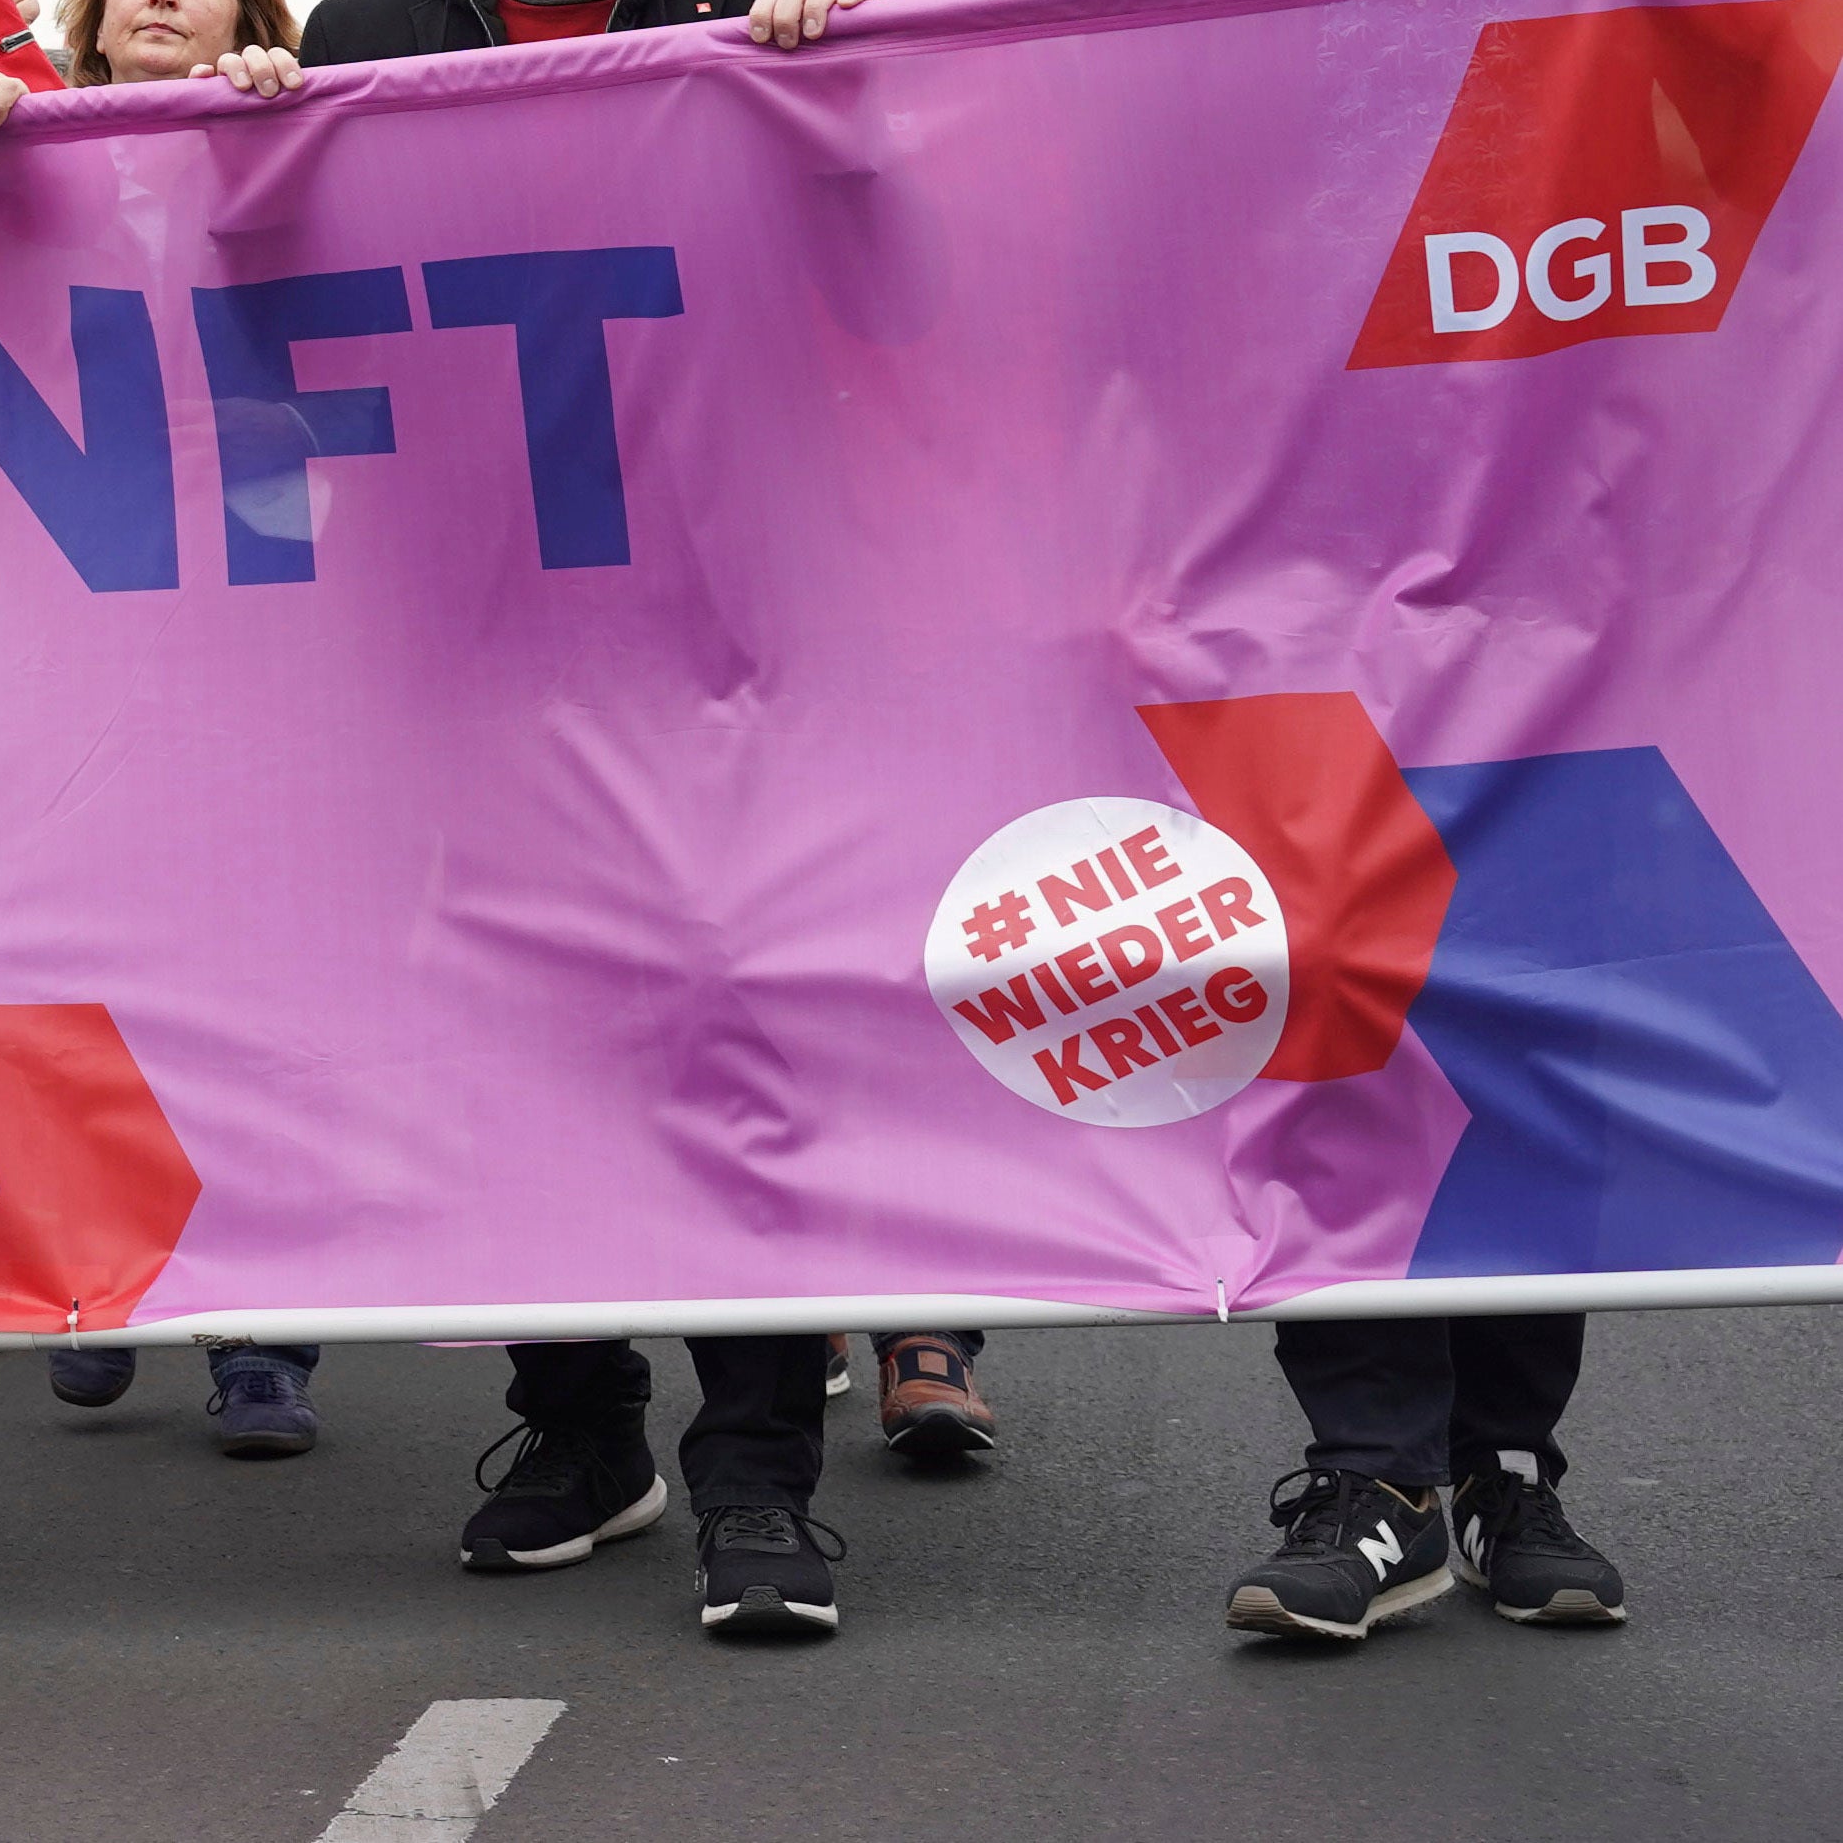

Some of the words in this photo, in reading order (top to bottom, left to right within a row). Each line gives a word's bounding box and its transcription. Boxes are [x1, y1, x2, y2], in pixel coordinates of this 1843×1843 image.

[1424, 204, 1717, 334] DGB
[952, 875, 1267, 1046] WIEDER
[1031, 966, 1268, 1106] KRIEG
